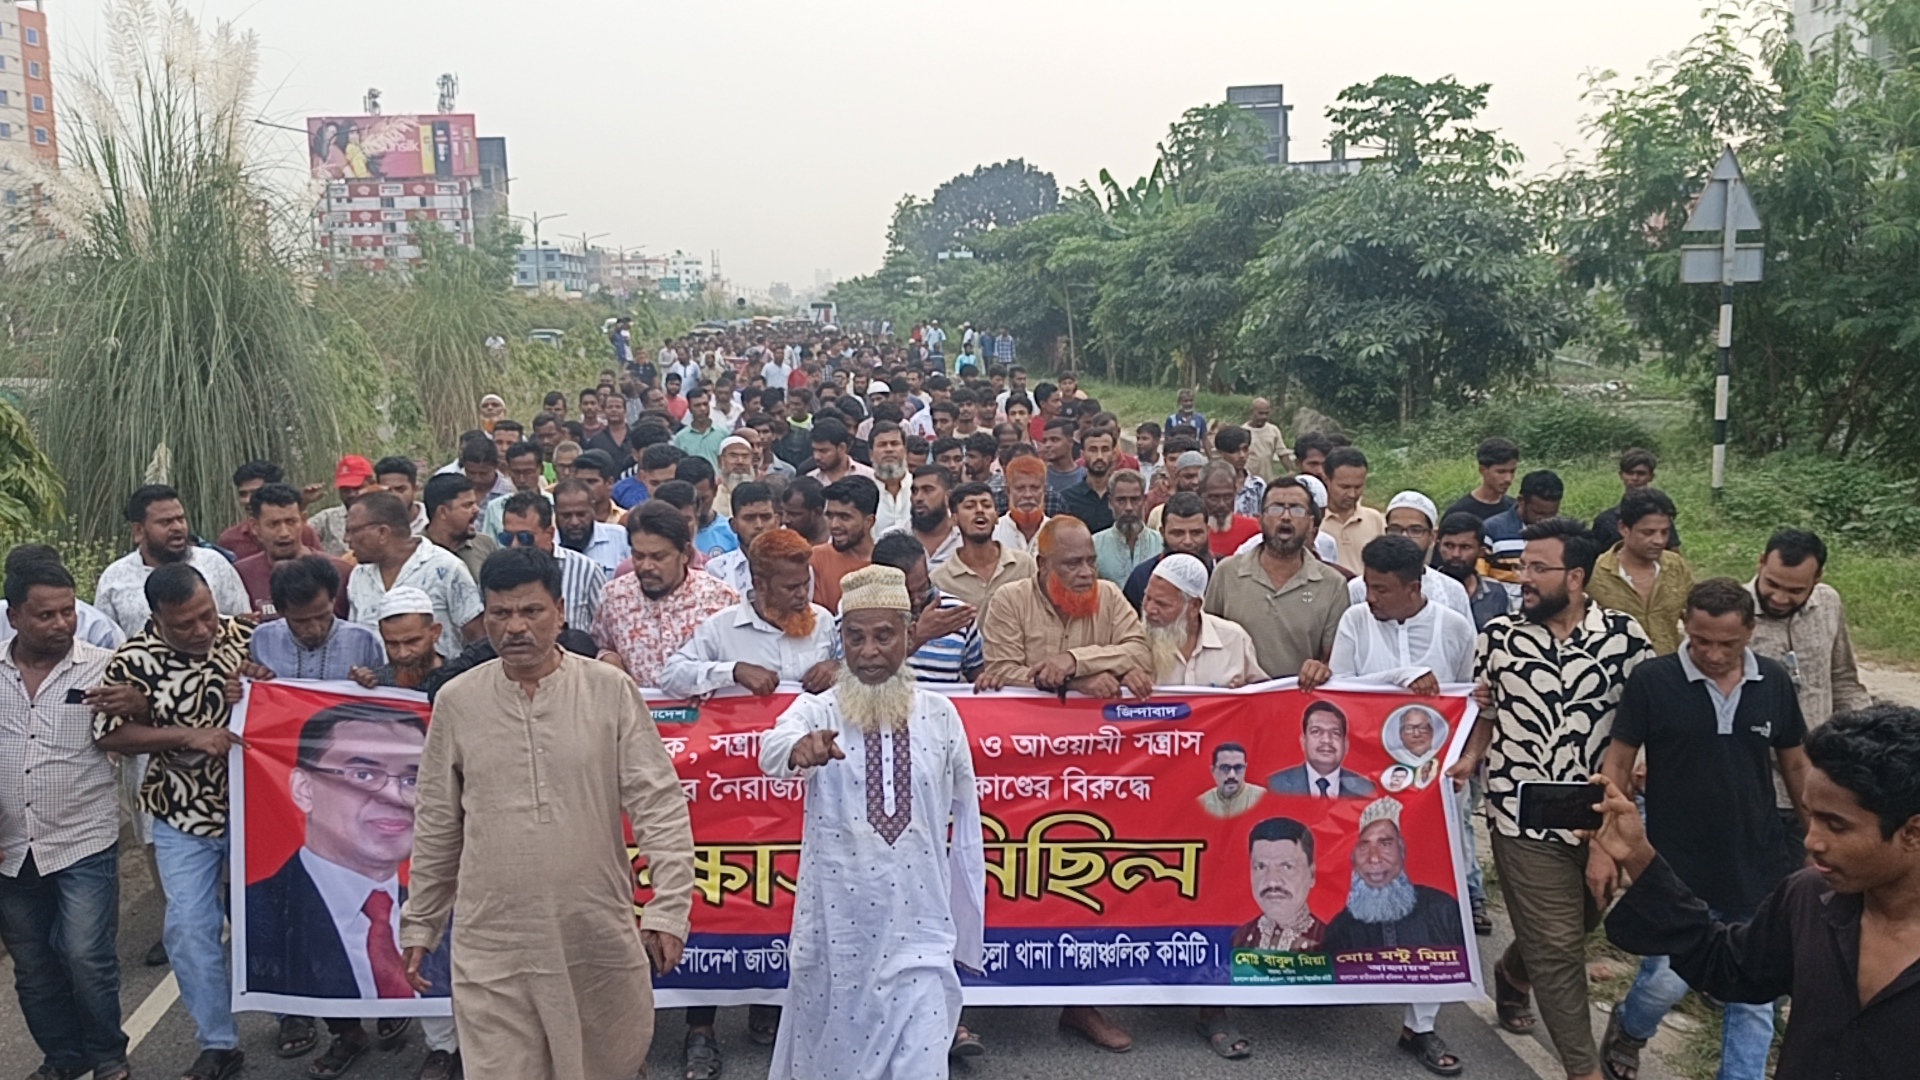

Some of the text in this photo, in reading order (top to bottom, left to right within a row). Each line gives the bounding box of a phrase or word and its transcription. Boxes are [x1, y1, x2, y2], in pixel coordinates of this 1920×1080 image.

[1116, 705, 1177, 719] জিন্দাবাদ
[1010, 725, 1126, 758] আওয়ামী
[1133, 728, 1205, 758] সন্ত্রাস
[1061, 766, 1155, 802] বিরুদ্ধে
[1015, 939, 1054, 970] থানা
[1262, 954, 1294, 969] বাবুল
